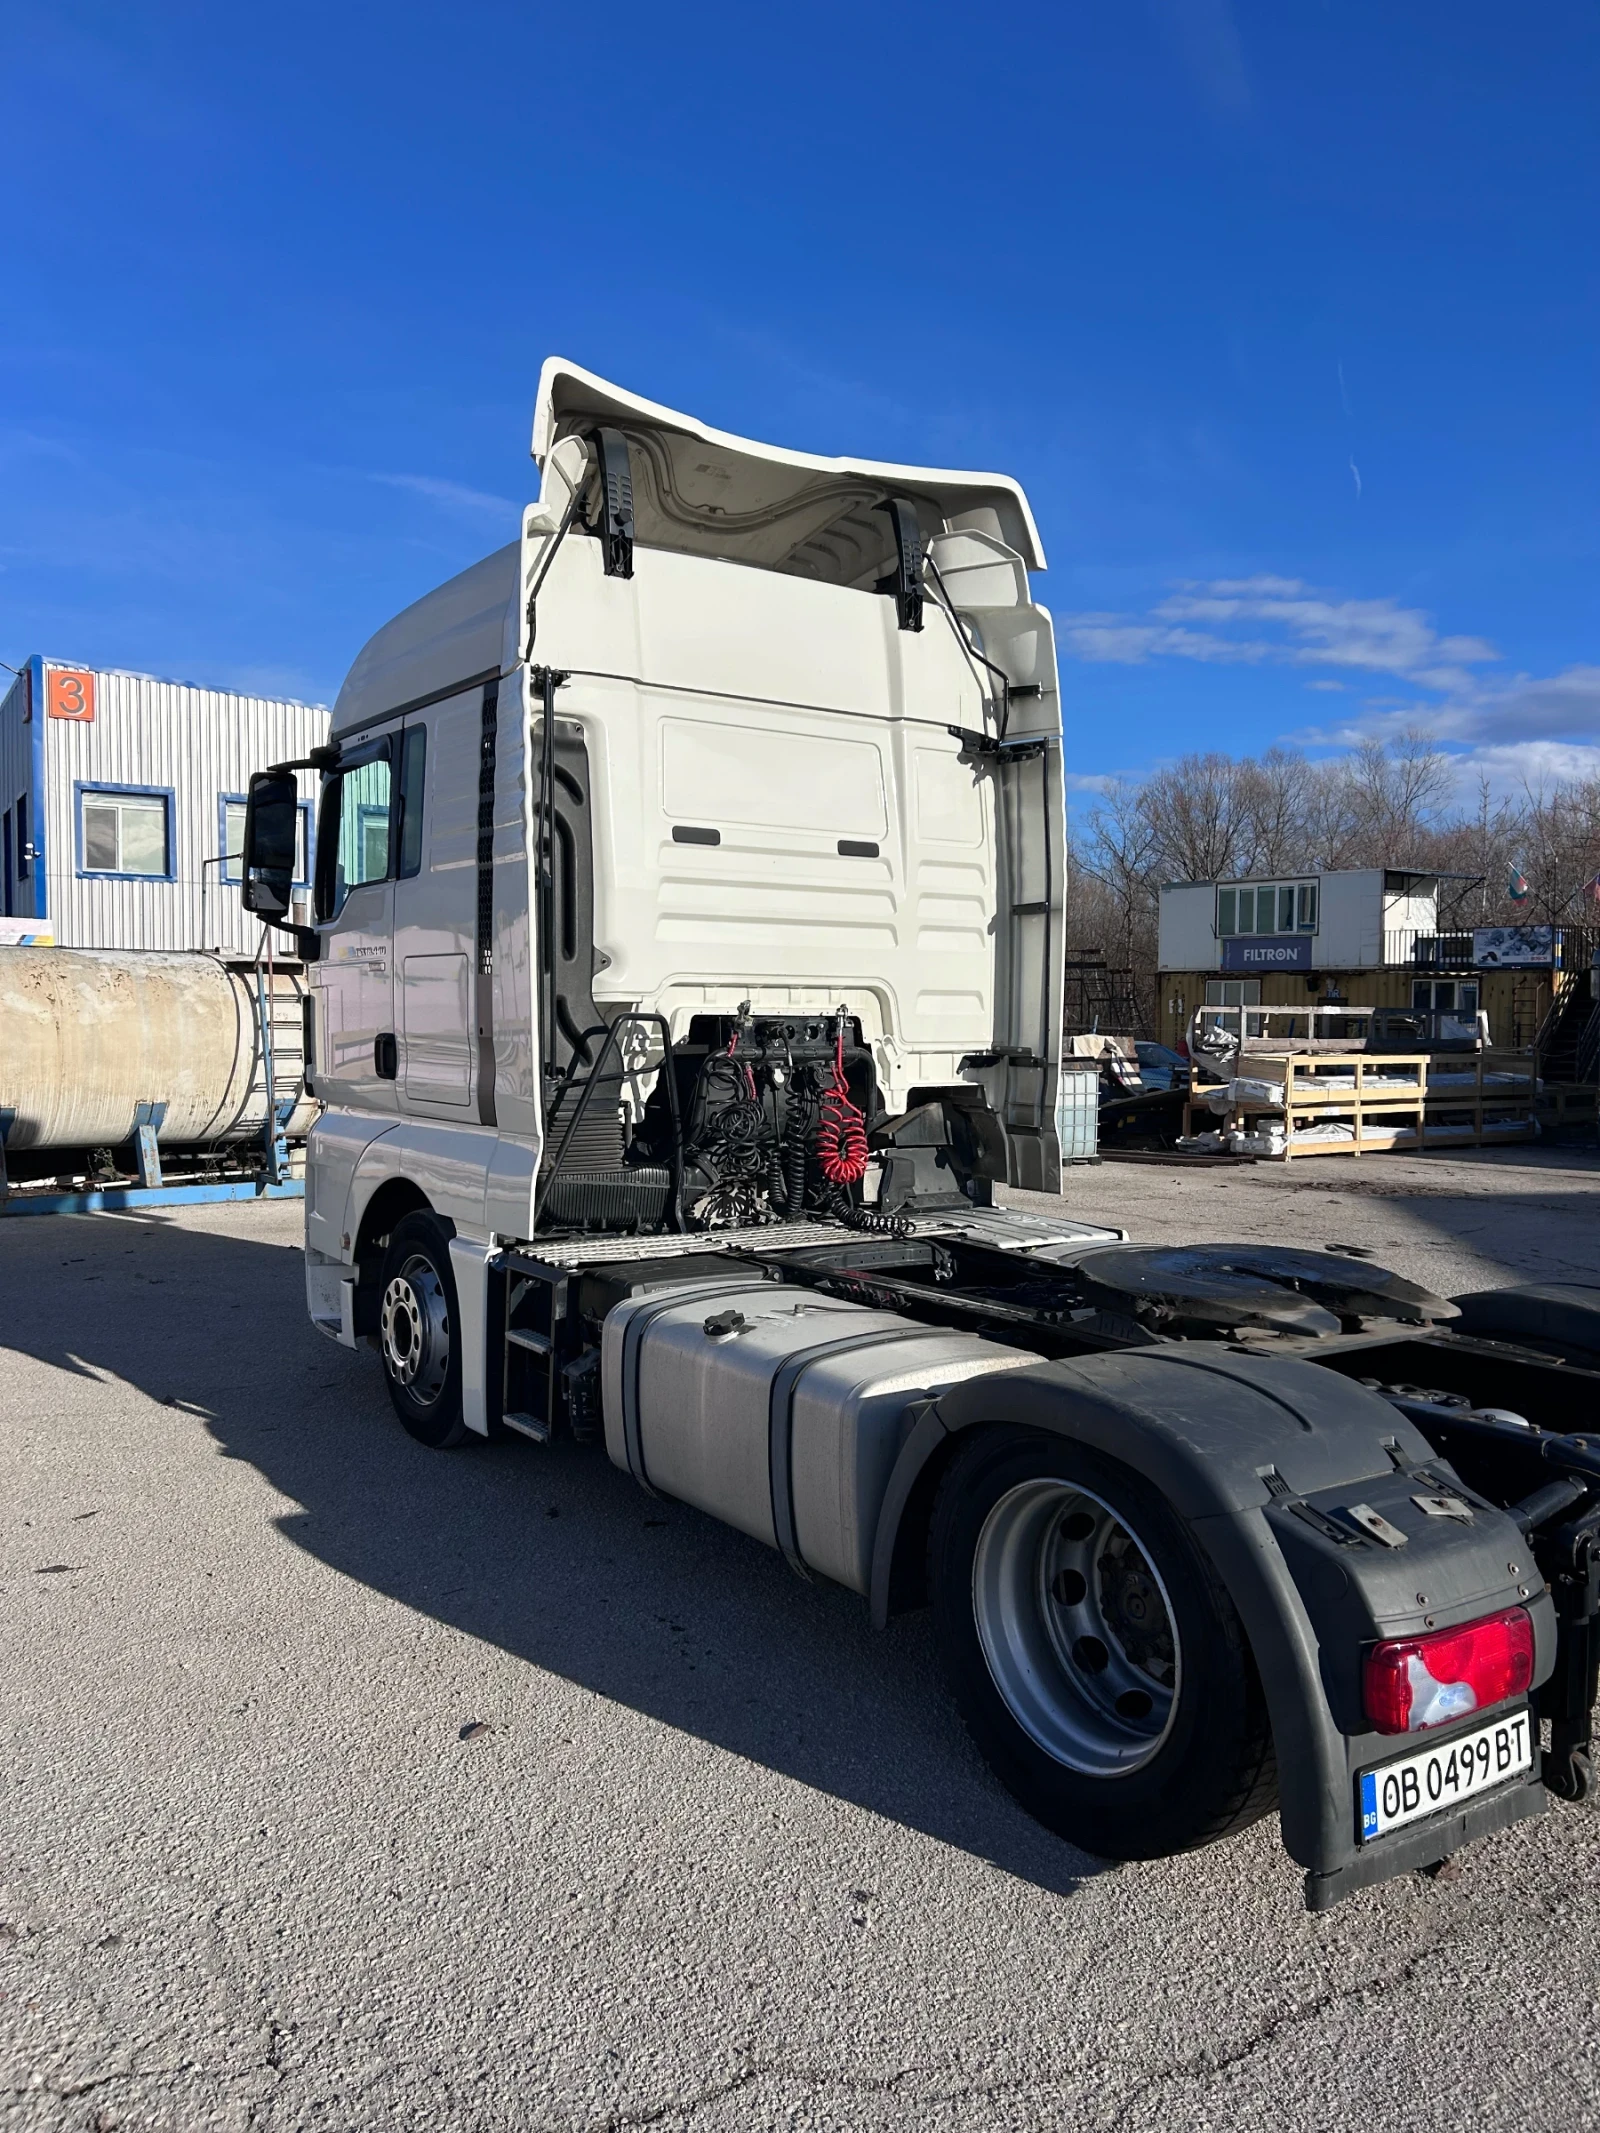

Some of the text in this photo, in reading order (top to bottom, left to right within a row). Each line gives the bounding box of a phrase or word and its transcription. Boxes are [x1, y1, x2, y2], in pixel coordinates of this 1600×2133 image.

[58, 676, 87, 716] 3
[1243, 948, 1298, 962] FILTRON
[1383, 1719, 1525, 1818] OB 0499 BT
[1363, 1812, 1377, 1829] BG
